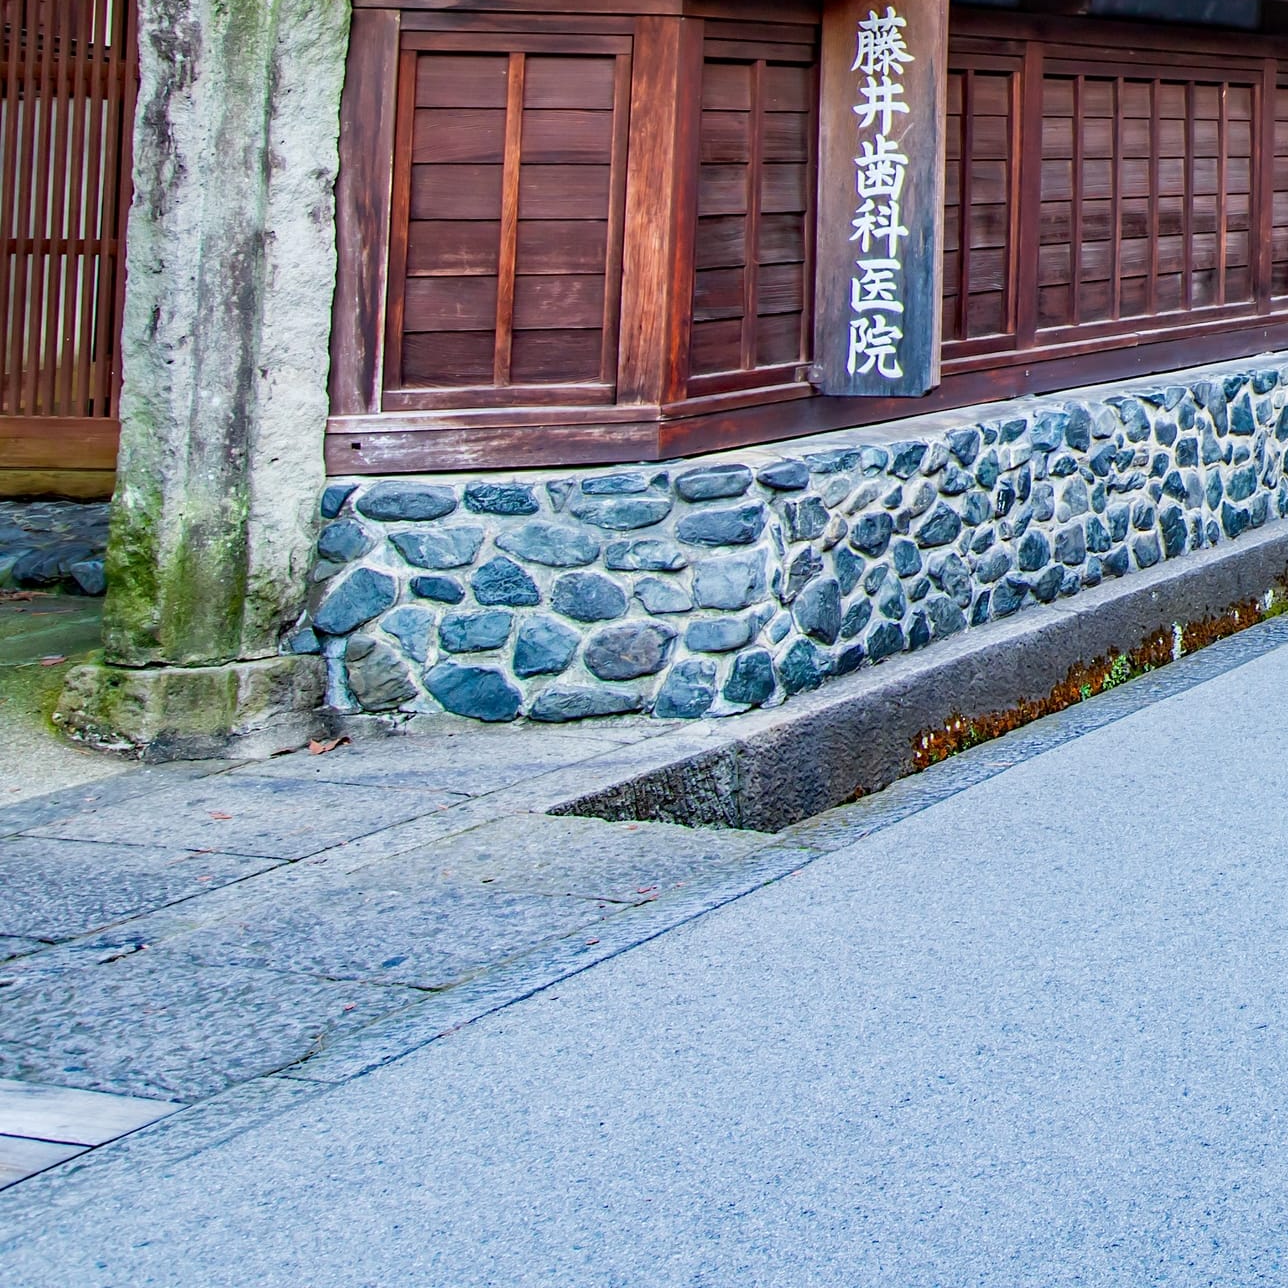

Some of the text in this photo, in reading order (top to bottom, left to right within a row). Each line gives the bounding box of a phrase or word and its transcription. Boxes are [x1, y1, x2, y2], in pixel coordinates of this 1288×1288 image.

[847, 6, 916, 379] 藤井歯科医院
